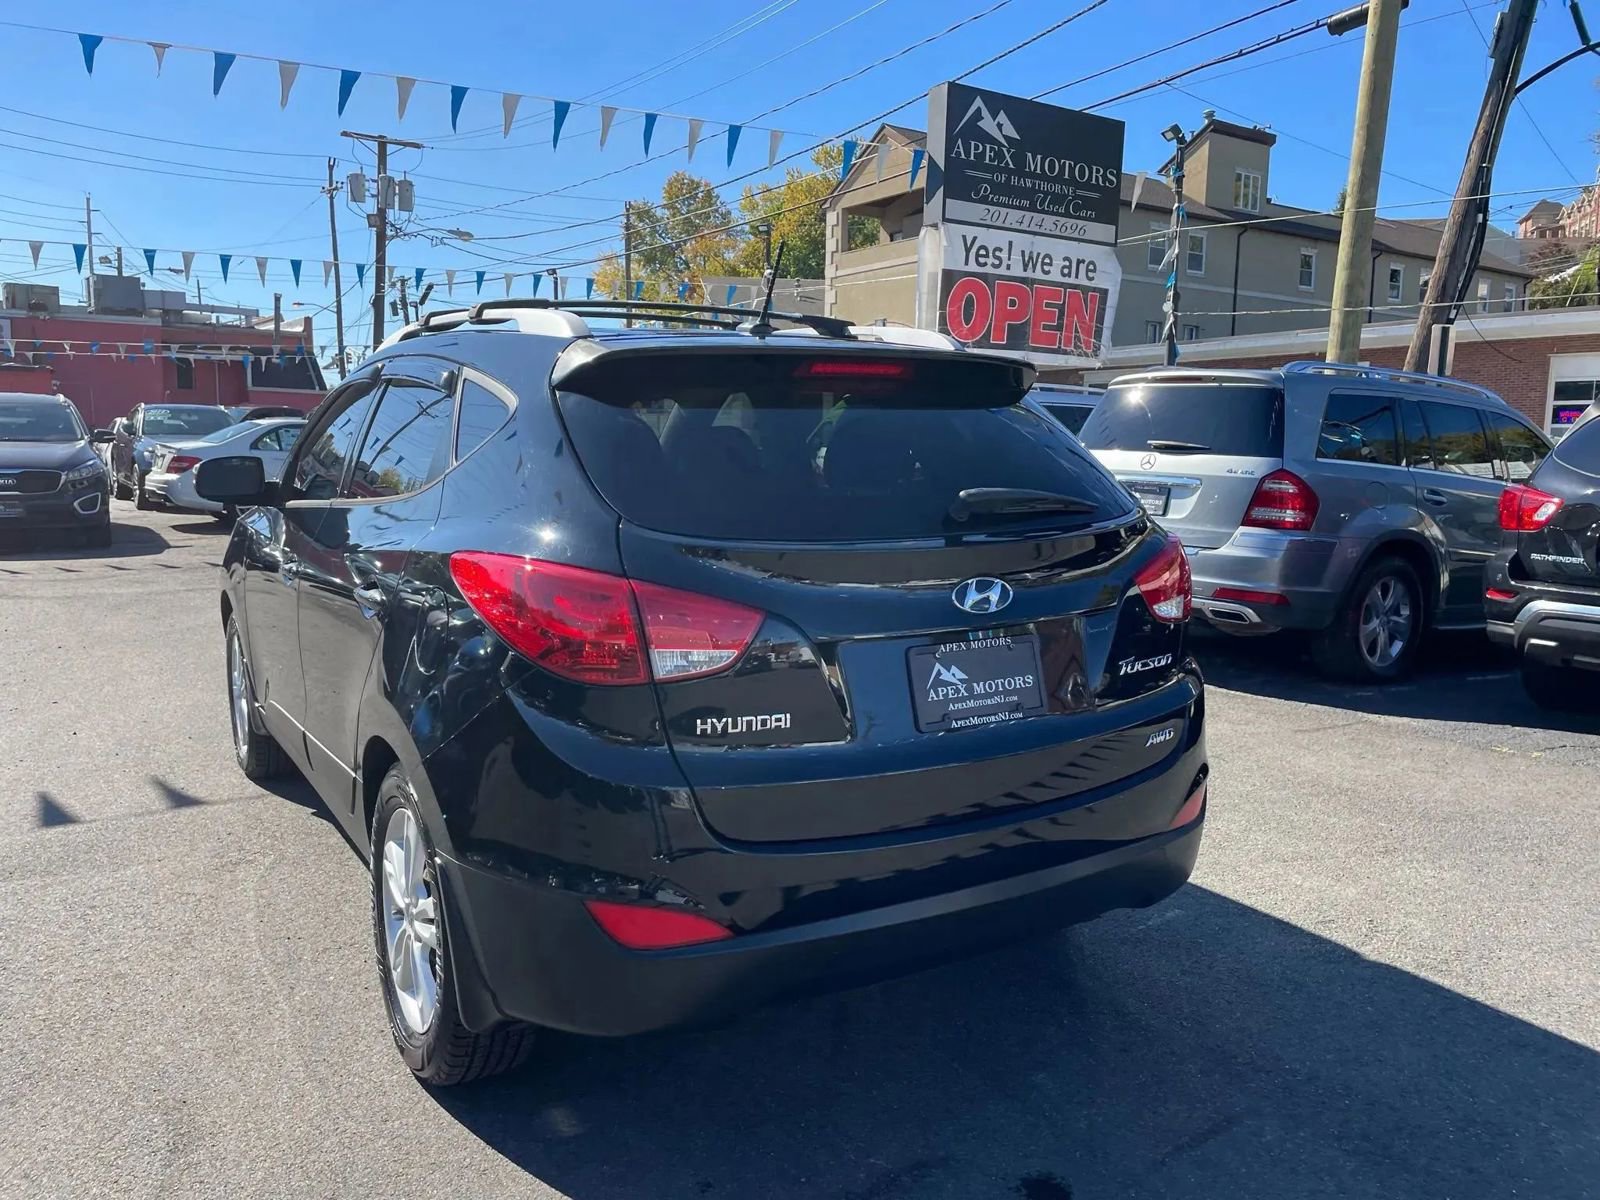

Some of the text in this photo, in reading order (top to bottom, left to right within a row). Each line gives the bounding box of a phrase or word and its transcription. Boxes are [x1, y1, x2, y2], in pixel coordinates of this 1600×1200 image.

[950, 138, 1118, 188] APEX MOTORS
[993, 172, 1075, 197] OF HAWTHORNE
[971, 183, 1096, 219] Premium Used Cars
[979, 207, 1087, 237] 201.414.5696
[961, 234, 1098, 282] Yes! we are
[946, 276, 1100, 351] OPEN
[1530, 553, 1584, 564] PATHFINDER
[939, 636, 1012, 653] APEX MOTORS
[927, 675, 1034, 702] APEX MOTORS
[696, 712, 791, 735] HYUNDAI
[1145, 728, 1175, 747] AWD
